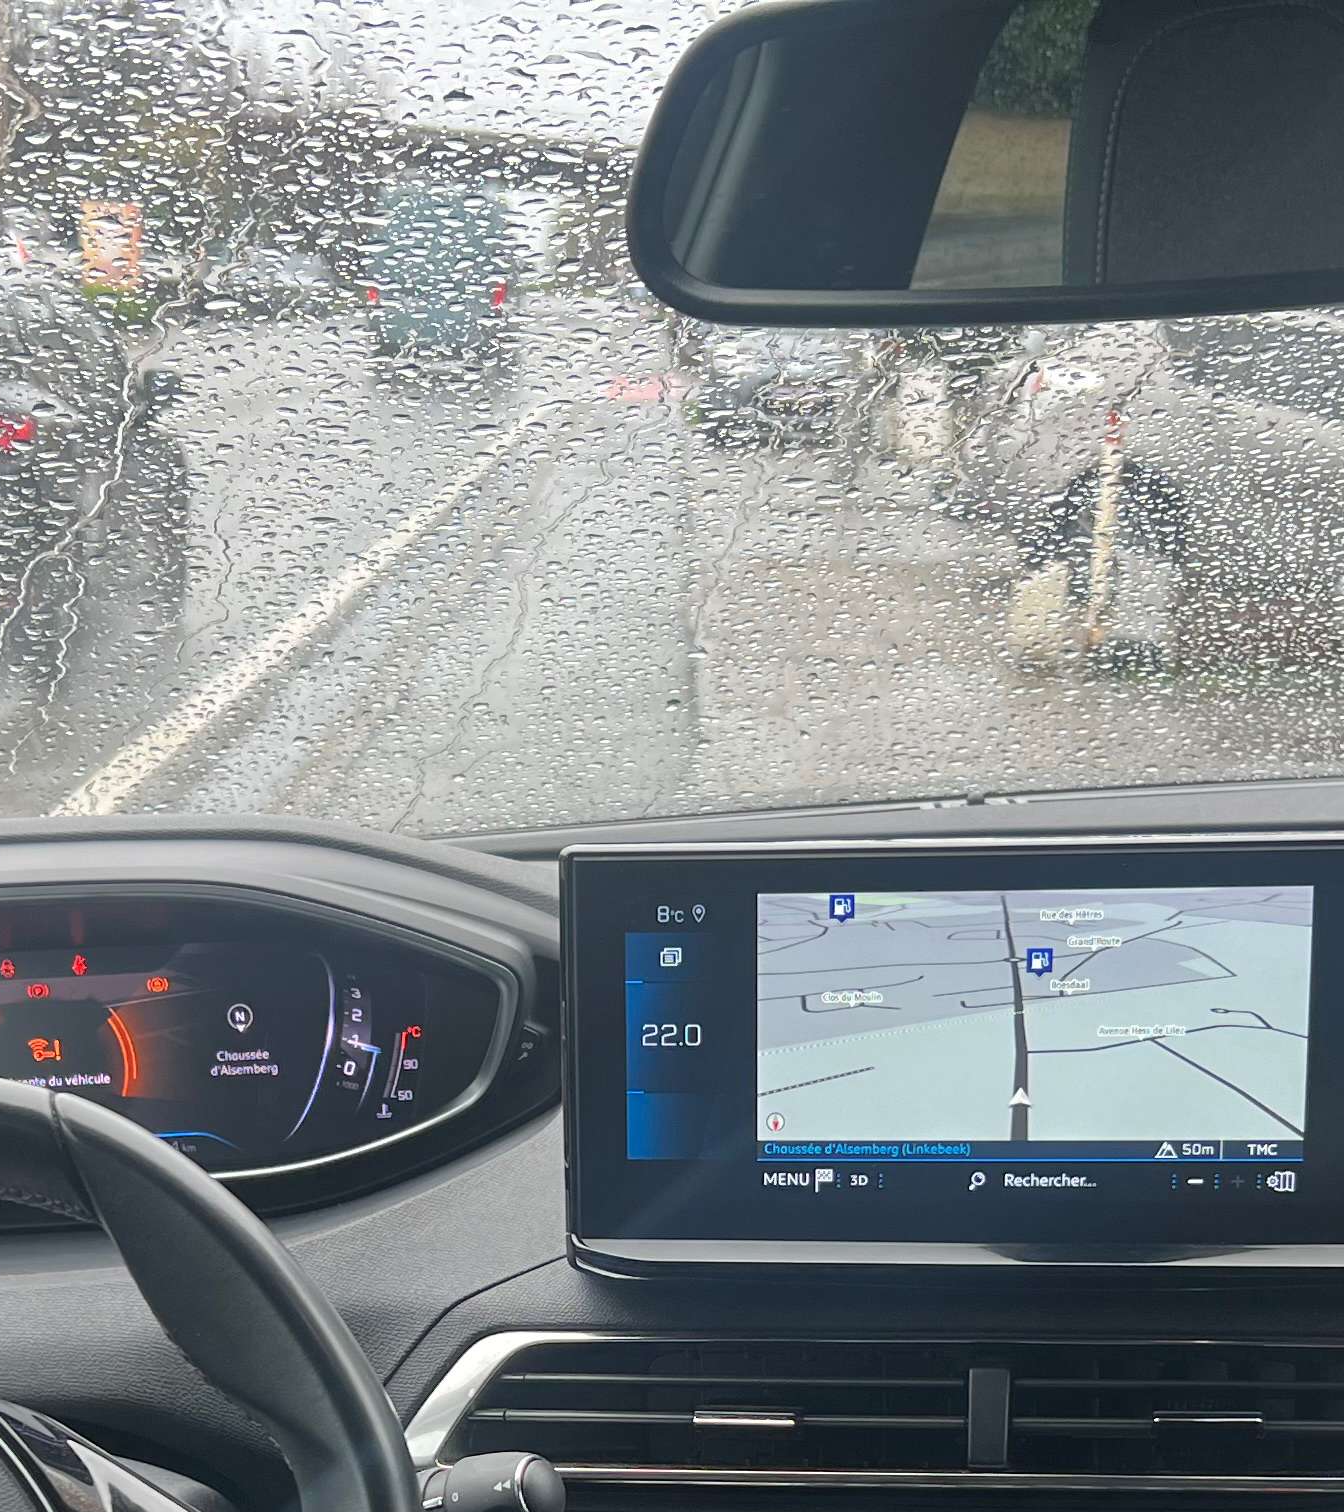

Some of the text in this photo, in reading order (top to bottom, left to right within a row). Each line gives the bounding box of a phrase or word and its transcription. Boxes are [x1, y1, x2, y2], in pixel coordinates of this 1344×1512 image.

[657, 906, 684, 923] 8°C
[1041, 911, 1057, 919] Rue
[1058, 911, 1074, 919] des
[351, 988, 361, 999] 3
[235, 1011, 245, 1021] N
[352, 1008, 362, 1022] 2
[642, 1024, 702, 1046] 22.0
[216, 1049, 270, 1062] Chaussée
[210, 1063, 279, 1076] d'Alsemberg
[344, 1061, 356, 1076] 0
[403, 1059, 418, 1070] 90
[49, 1076, 63, 1086] du
[65, 1073, 111, 1086] véhicule
[398, 1090, 413, 1100] 50
[764, 1143, 971, 1157] Chaussée d'Alsemberg (Linkebeek)
[1182, 1143, 1214, 1156] 50m
[1247, 1143, 1278, 1156] TMC
[763, 1172, 810, 1186] MENU
[850, 1174, 868, 1186] 3D
